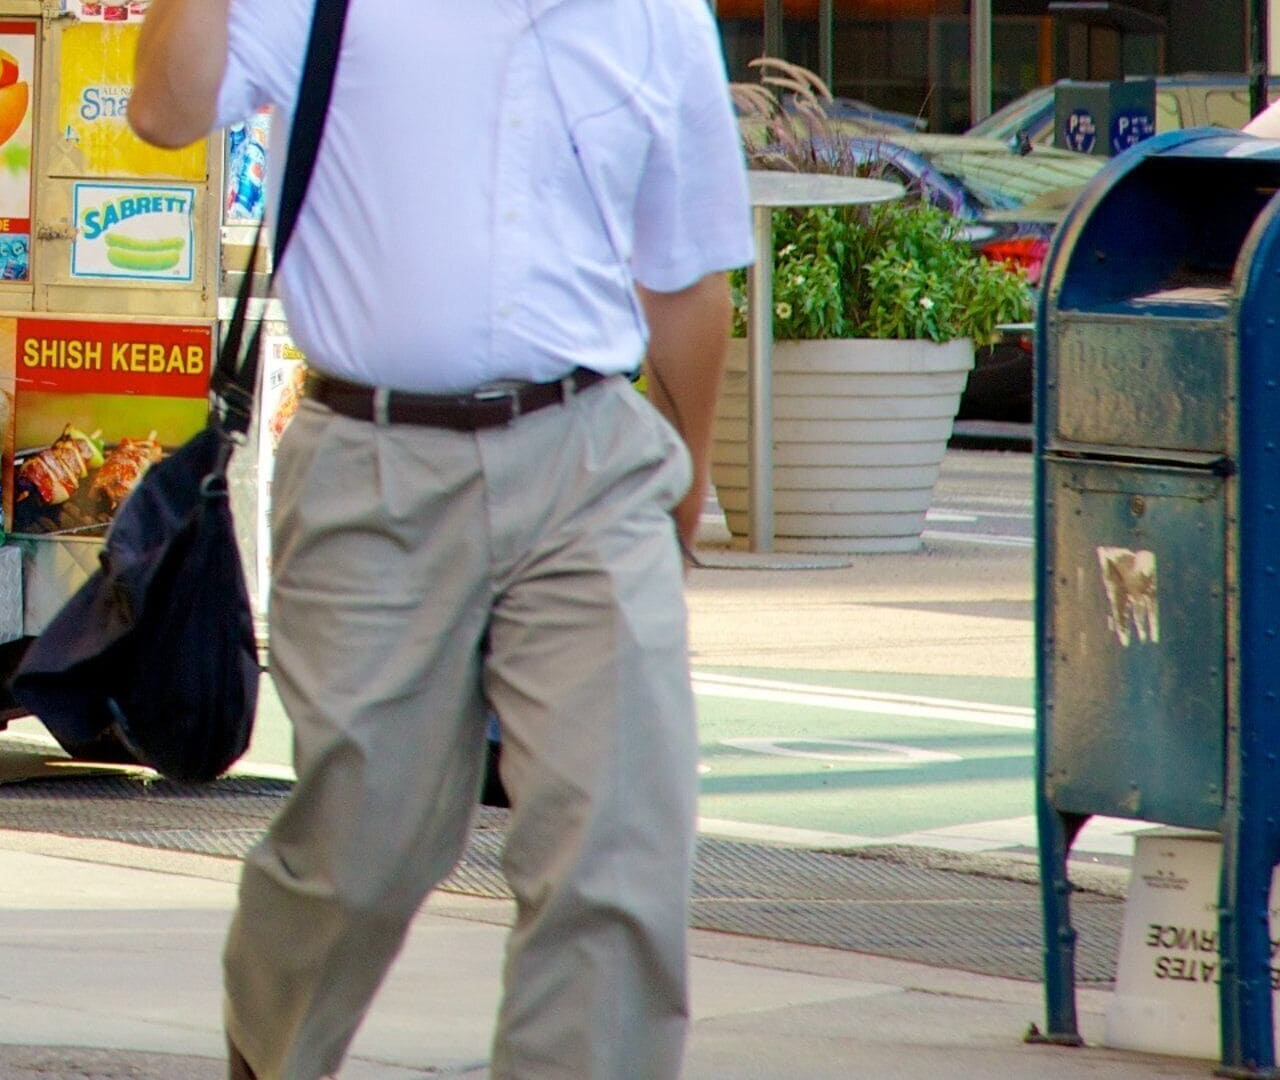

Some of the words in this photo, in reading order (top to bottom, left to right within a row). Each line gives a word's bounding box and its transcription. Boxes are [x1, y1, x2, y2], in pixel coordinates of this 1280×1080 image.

[83, 196, 187, 240] SABRETT
[23, 338, 102, 370] SHISH
[110, 342, 204, 375] KEBAB
[1147, 923, 1221, 954] RVICE
[1155, 955, 1221, 986] ATES
